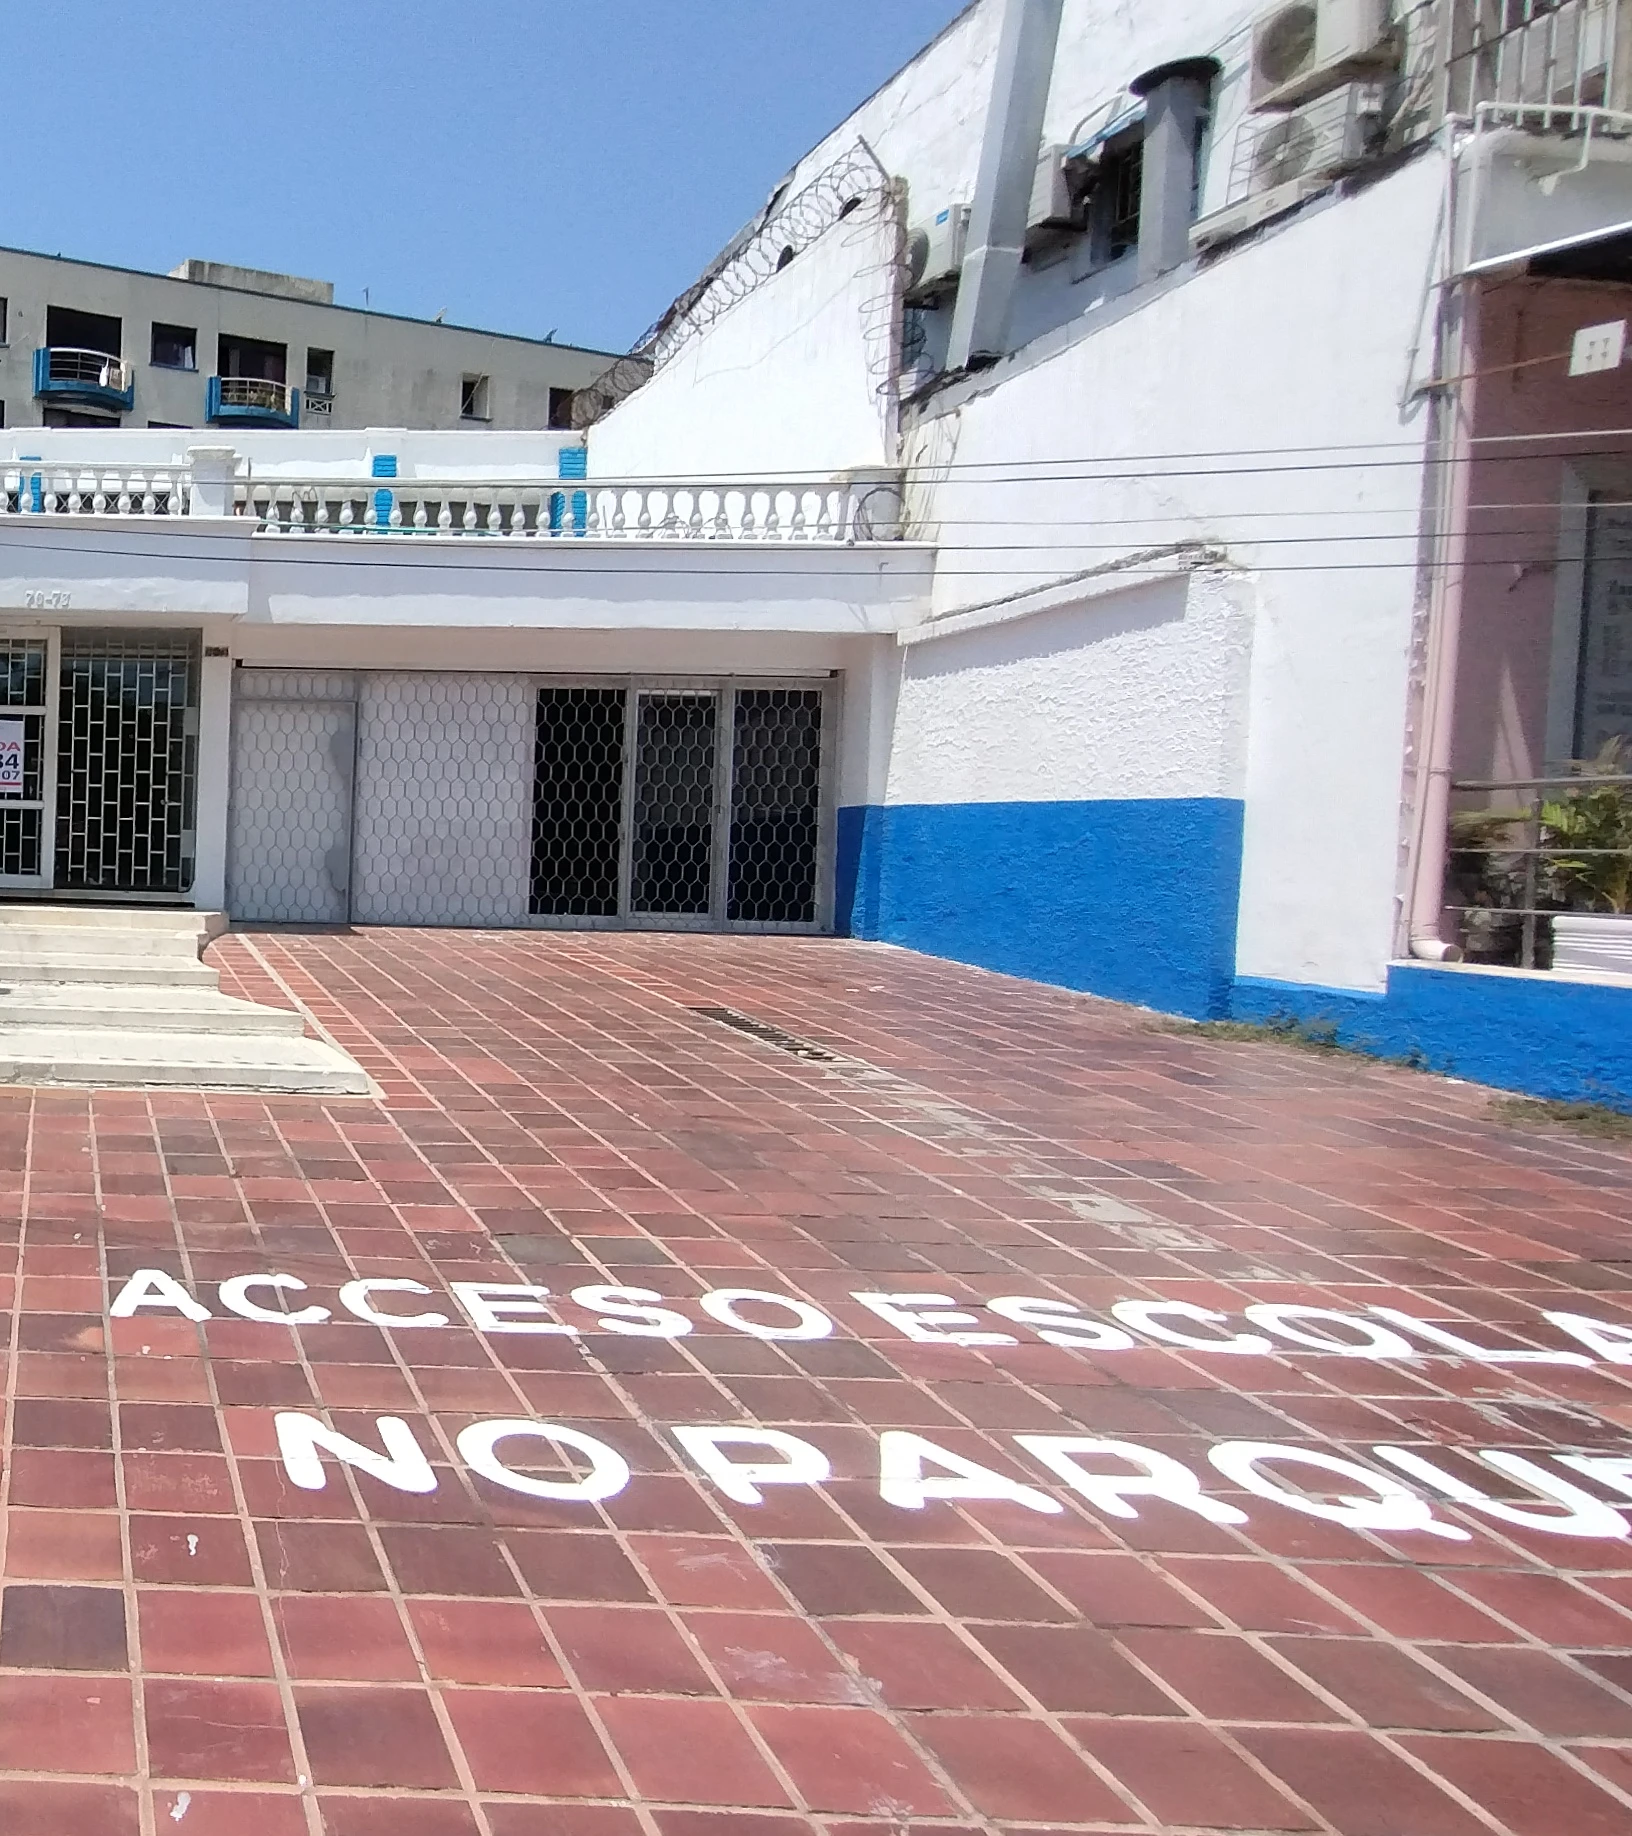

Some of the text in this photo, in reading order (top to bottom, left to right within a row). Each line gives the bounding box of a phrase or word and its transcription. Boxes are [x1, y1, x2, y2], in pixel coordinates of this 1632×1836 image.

[1, 770, 21, 780] 07
[109, 1268, 834, 1340] ACCESO
[273, 1411, 630, 1502] NO
